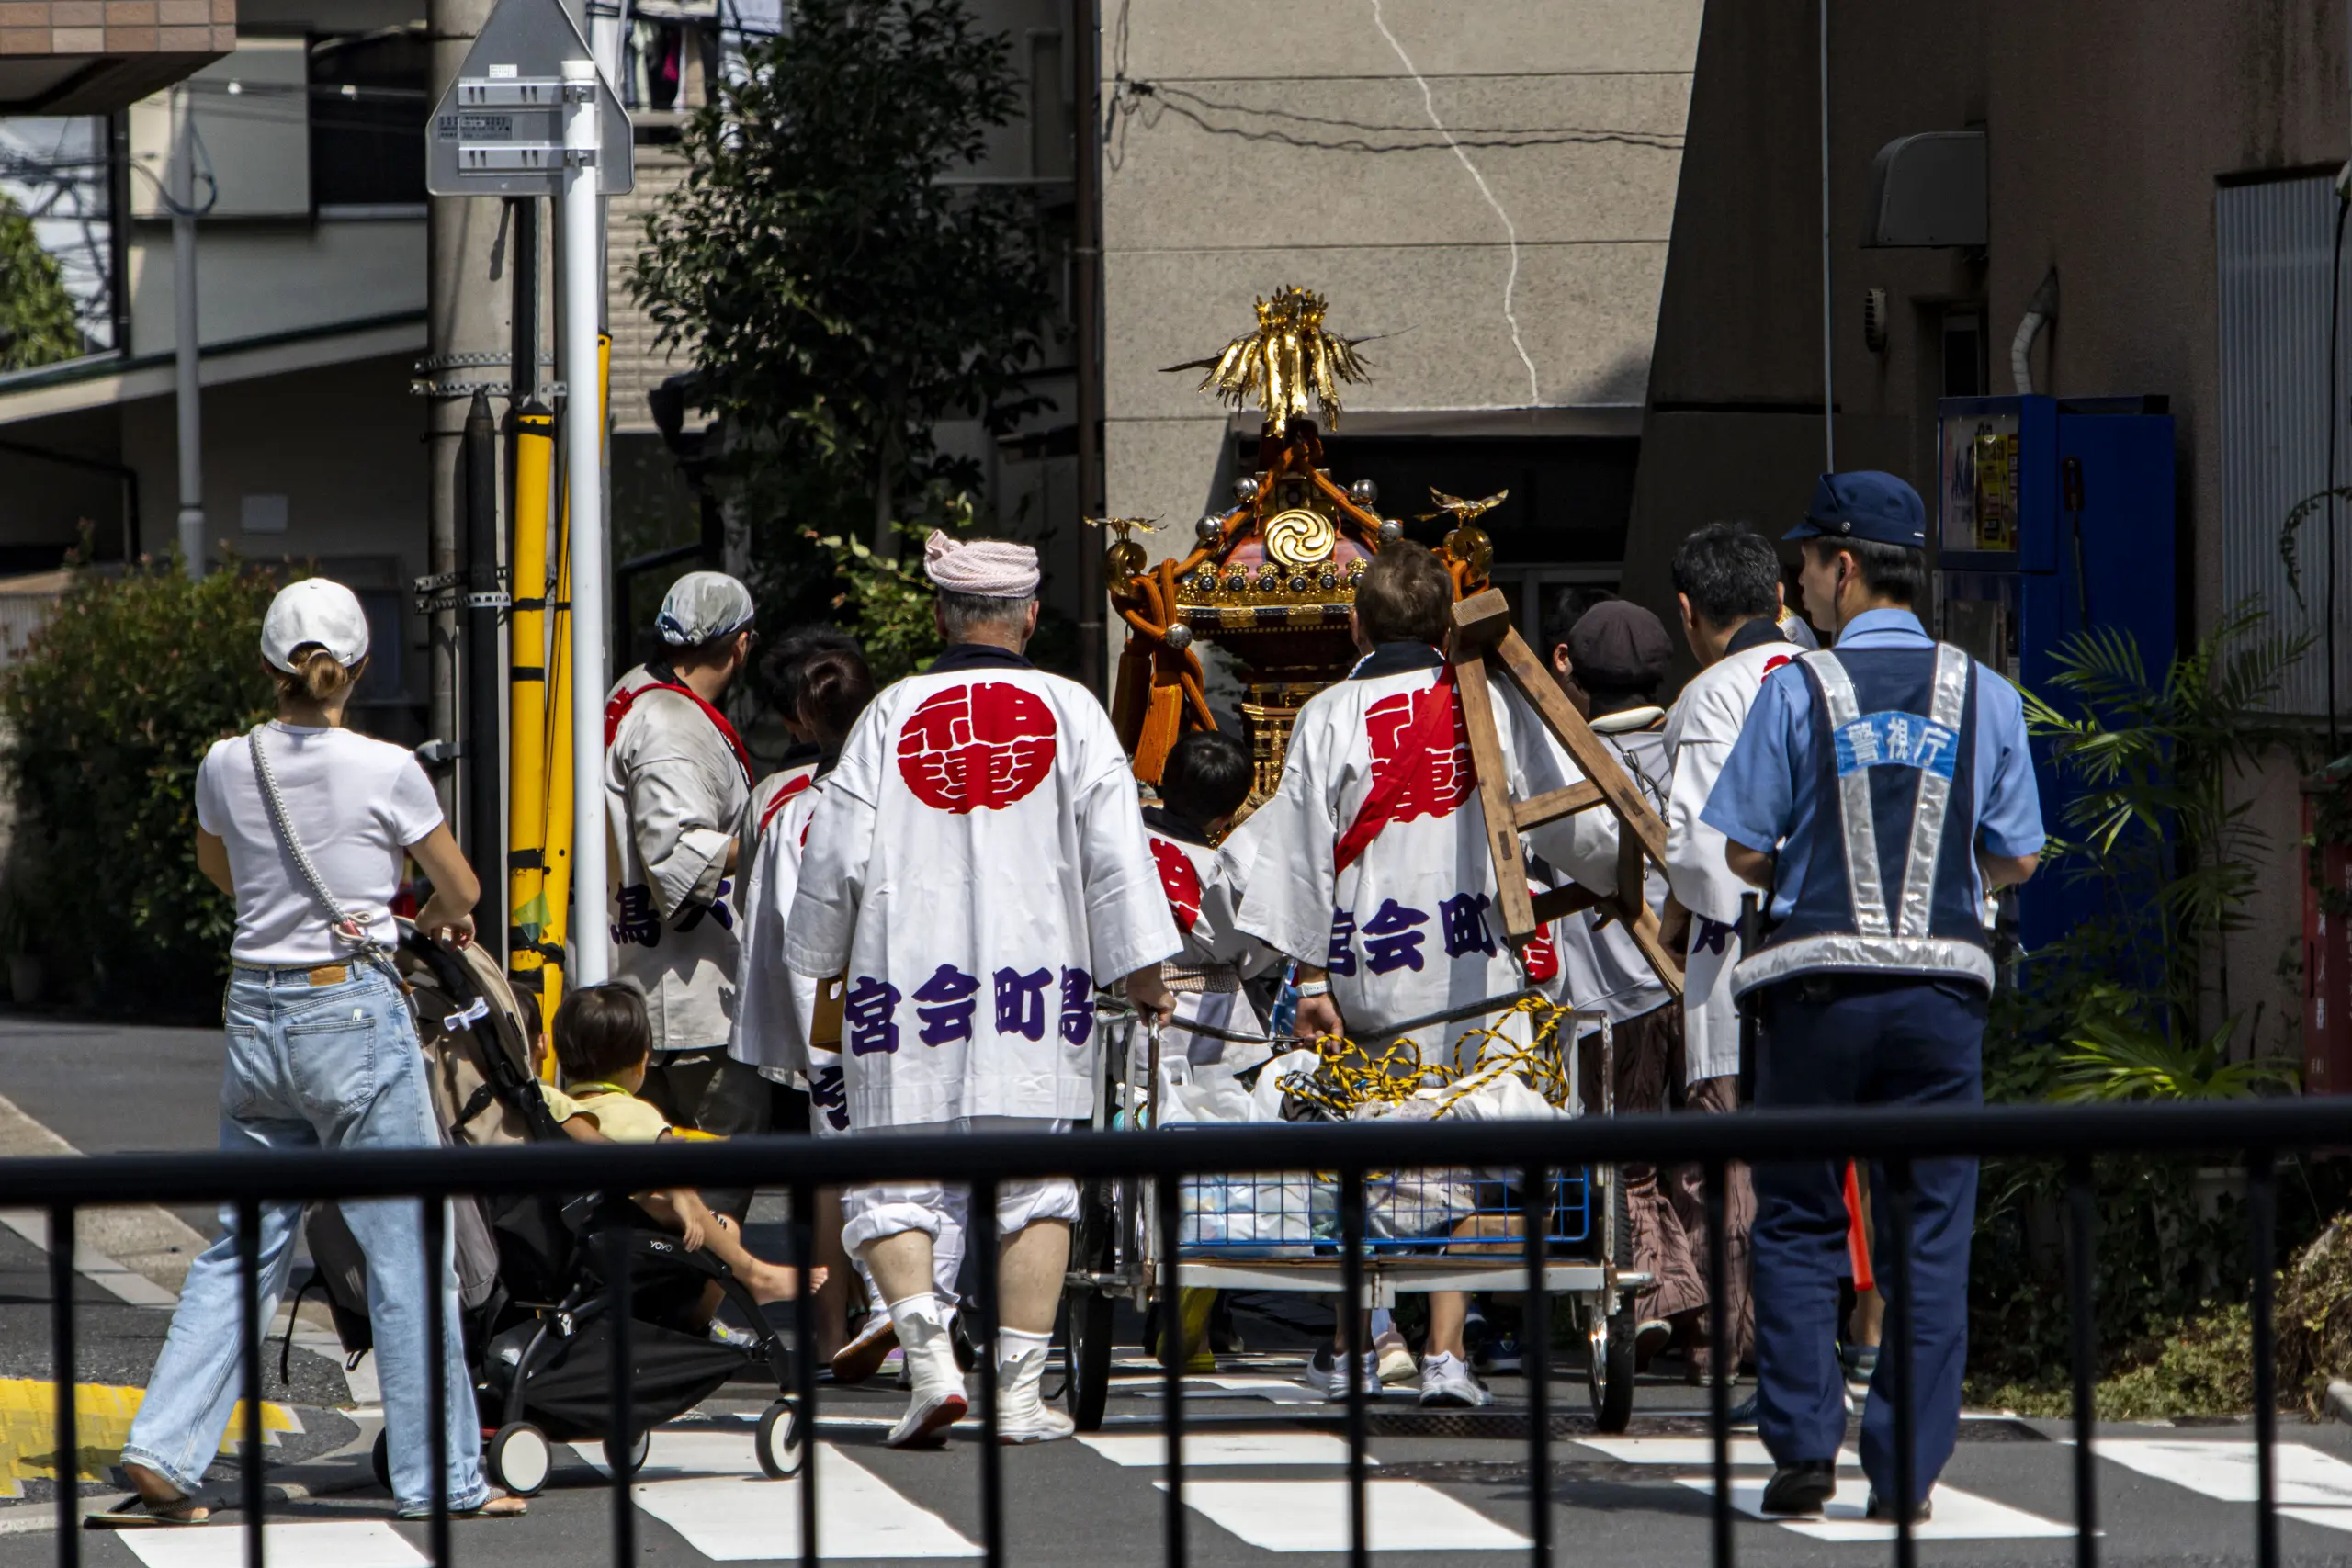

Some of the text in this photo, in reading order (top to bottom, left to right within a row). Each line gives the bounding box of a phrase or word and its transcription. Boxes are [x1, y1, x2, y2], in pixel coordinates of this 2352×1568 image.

[1846, 716, 1952, 768] 警視庁
[650, 1240, 673, 1253] YOYO
